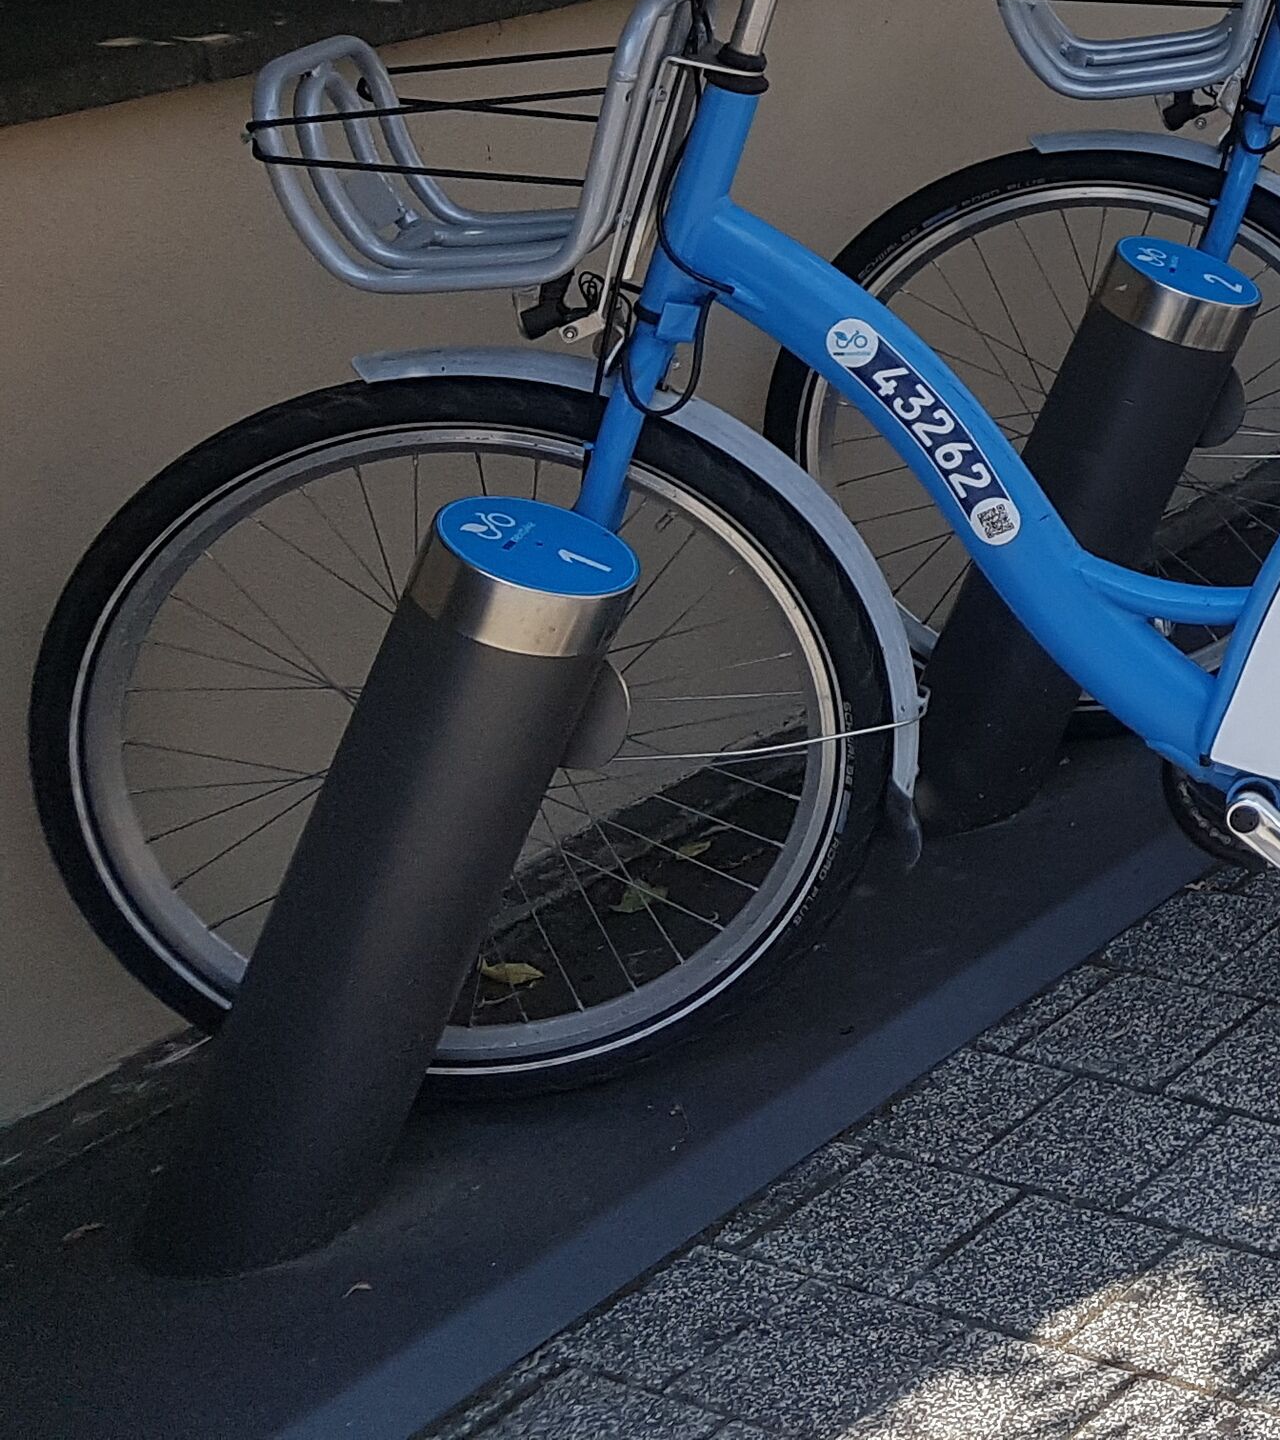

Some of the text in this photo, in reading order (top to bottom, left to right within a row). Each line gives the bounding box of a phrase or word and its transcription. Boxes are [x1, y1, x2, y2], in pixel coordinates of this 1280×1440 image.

[1203, 273, 1243, 294] 2
[872, 366, 992, 500] 43262
[557, 548, 613, 573] 1
